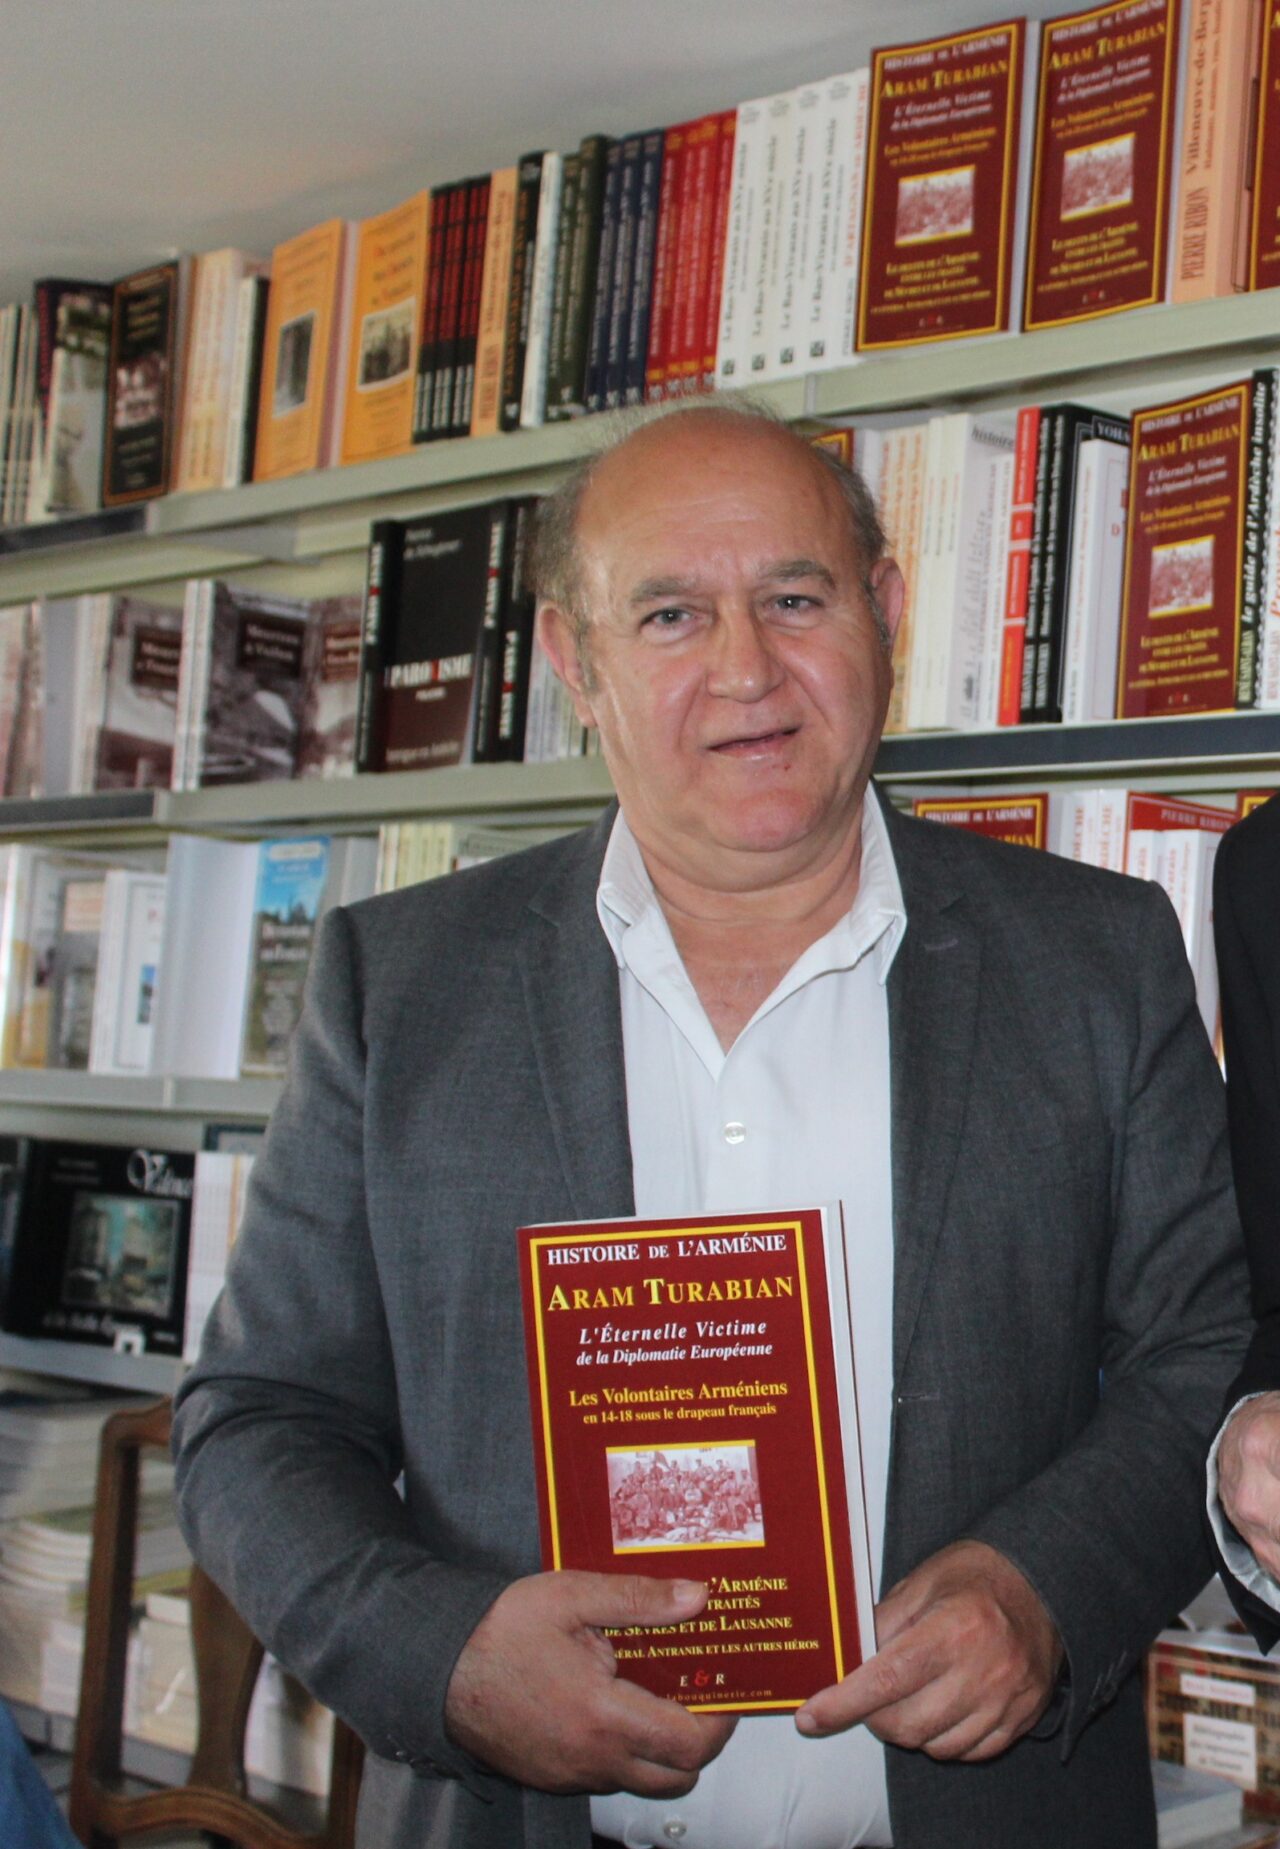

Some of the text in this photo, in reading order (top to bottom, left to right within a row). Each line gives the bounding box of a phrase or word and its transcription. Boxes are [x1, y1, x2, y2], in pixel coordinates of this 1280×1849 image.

[1243, 555, 1257, 605] guide
[548, 1232, 787, 1266] HISTOIRE DE L'ARMÉNIE
[548, 1276, 792, 1312] ARAM TURABIAN
[580, 1320, 766, 1344] L'Éternelle Victime
[576, 1342, 772, 1366] de la Diplomatie Européenne
[570, 1380, 788, 1406] Les Volontaires Arméniens
[582, 1402, 776, 1424] en 14-18 sous le drapeau français
[707, 1597, 760, 1611] TRAITÉS
[679, 1621, 696, 1633] ET
[699, 1619, 717, 1632] DE
[719, 1616, 792, 1631] LAUSANNE
[647, 1645, 704, 1658] ANTRANIK
[705, 1645, 718, 1654] ET
[721, 1643, 741, 1653] LES
[742, 1641, 783, 1652] AUTRES
[784, 1639, 819, 1650] HÉROS
[679, 1669, 725, 1687] E & R
